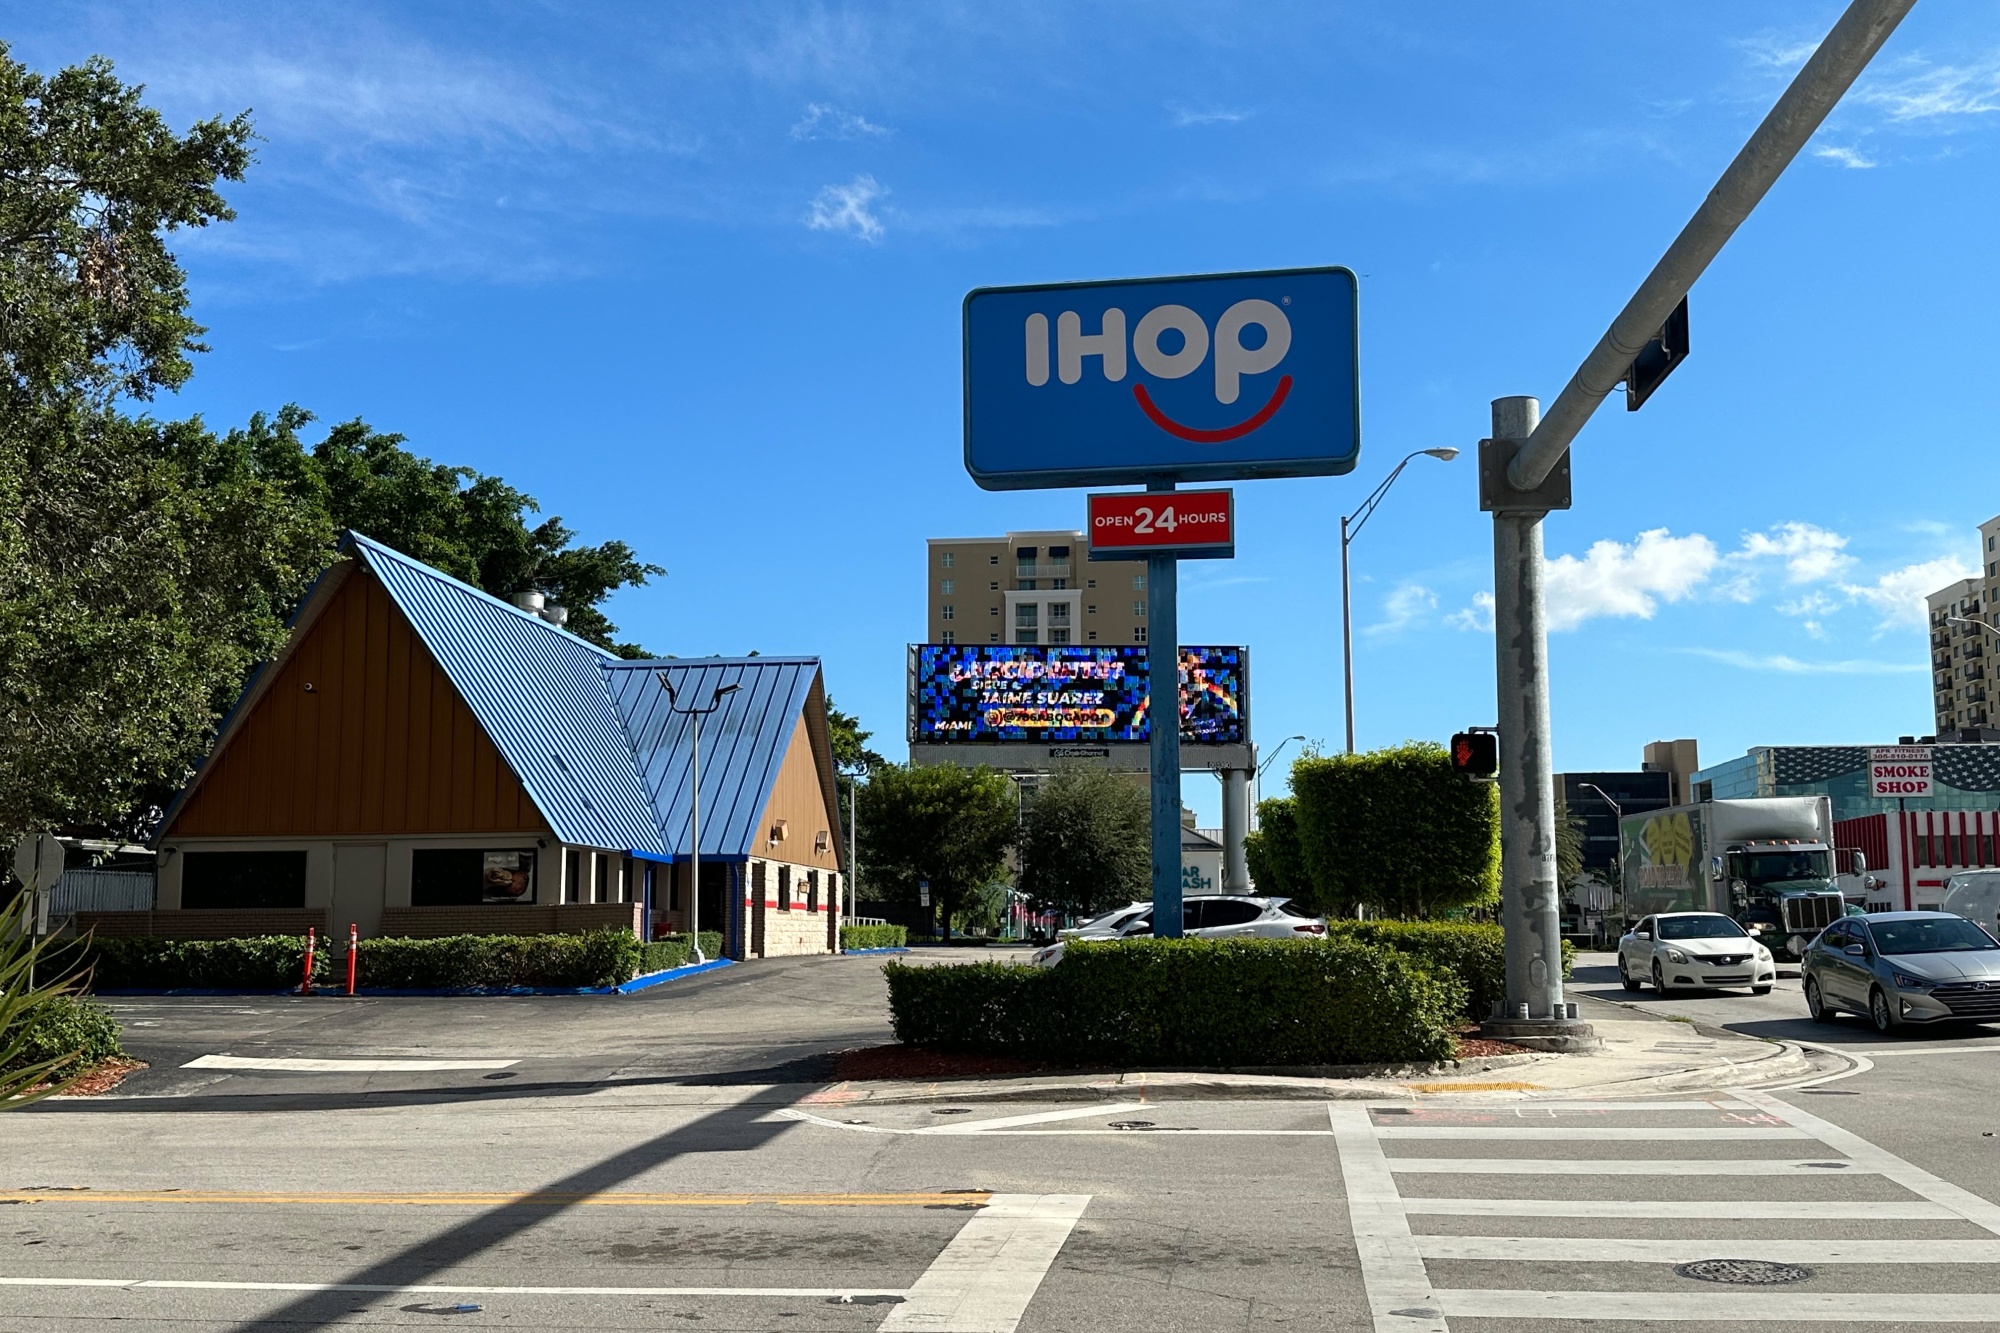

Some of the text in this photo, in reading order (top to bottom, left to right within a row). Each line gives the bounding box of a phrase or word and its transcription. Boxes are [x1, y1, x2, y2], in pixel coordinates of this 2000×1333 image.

[1025, 299, 1292, 404] IHOP
[1095, 506, 1226, 534] OPEN 24 HOURS
[980, 692, 1104, 704] JAIME SUAREZ
[1874, 766, 1929, 778] SMOKE
[1877, 781, 1928, 793] SHOP
[1183, 866, 1200, 877] AR
[1183, 877, 1212, 889] ASH
